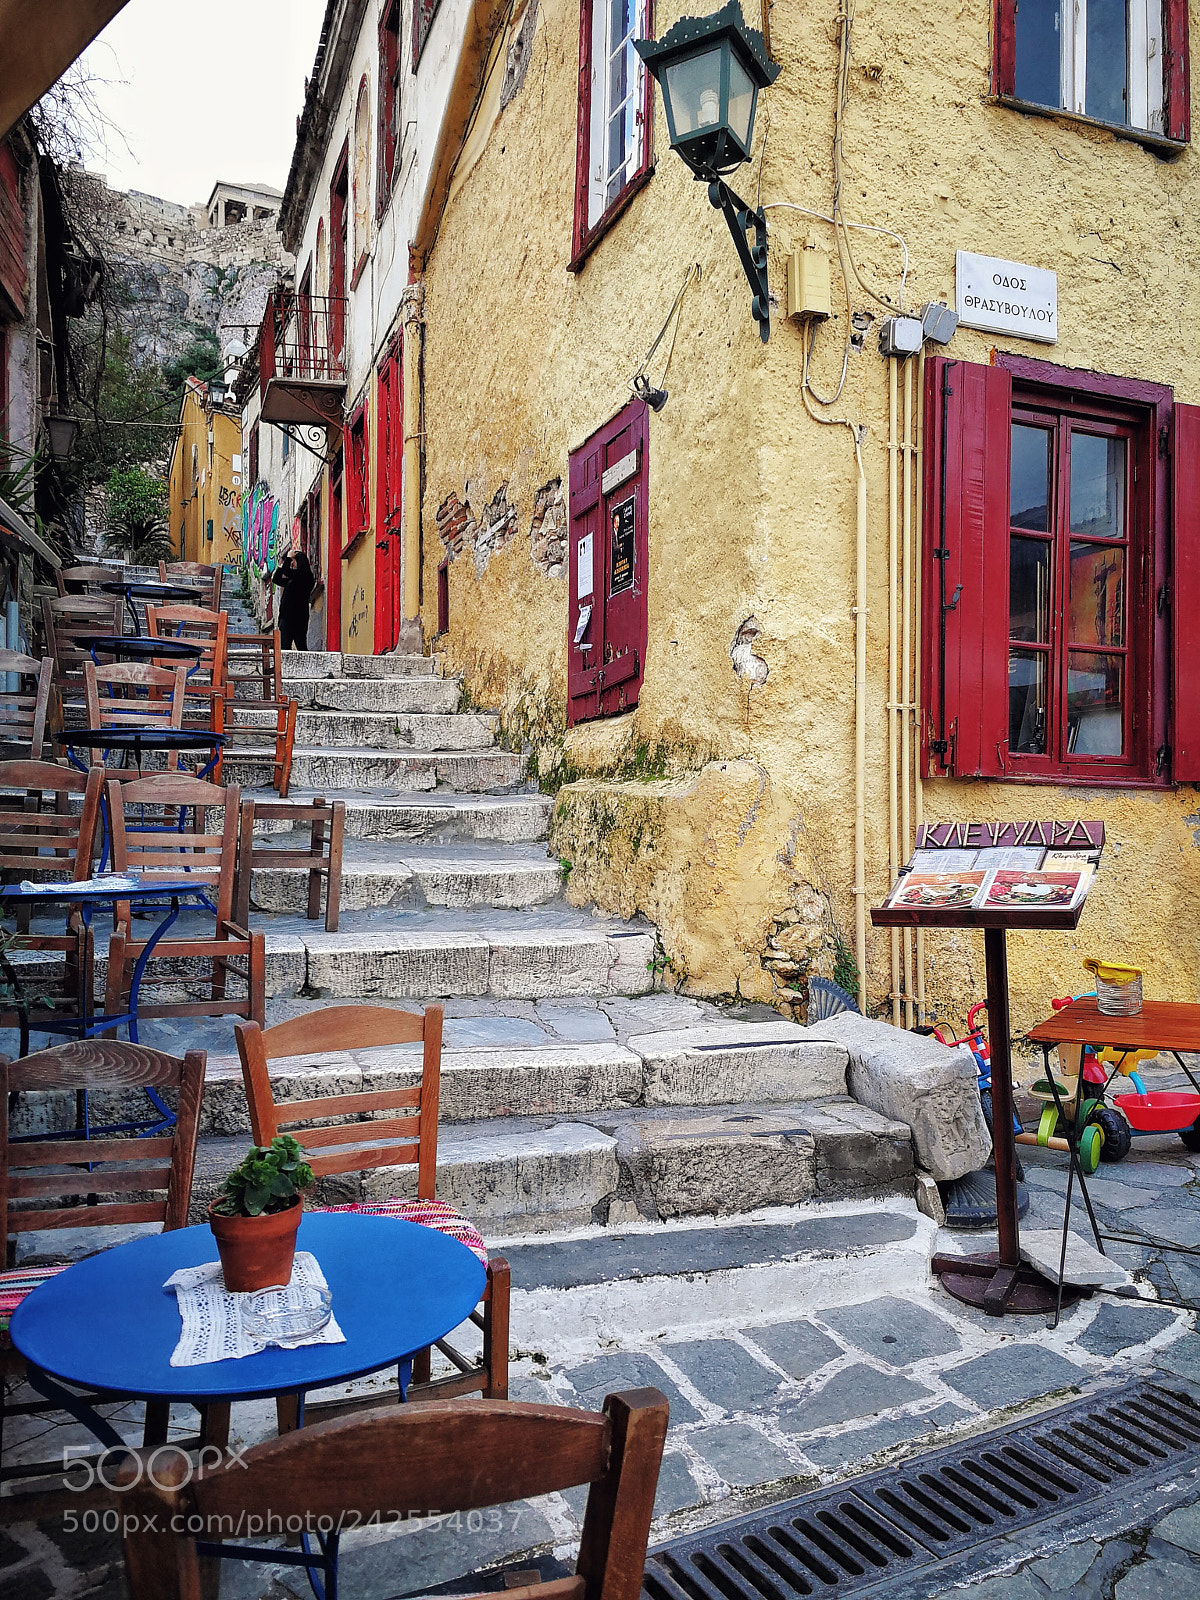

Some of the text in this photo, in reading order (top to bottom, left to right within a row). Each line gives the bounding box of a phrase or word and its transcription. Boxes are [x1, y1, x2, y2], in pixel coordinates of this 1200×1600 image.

[992, 273, 1027, 291] ΟΔΟΣ
[964, 295, 1054, 323] ΘΡΑΣΥΒΟΥΛΟΥ
[921, 820, 1094, 848] ΚΛΕΨΥΔΡΑ
